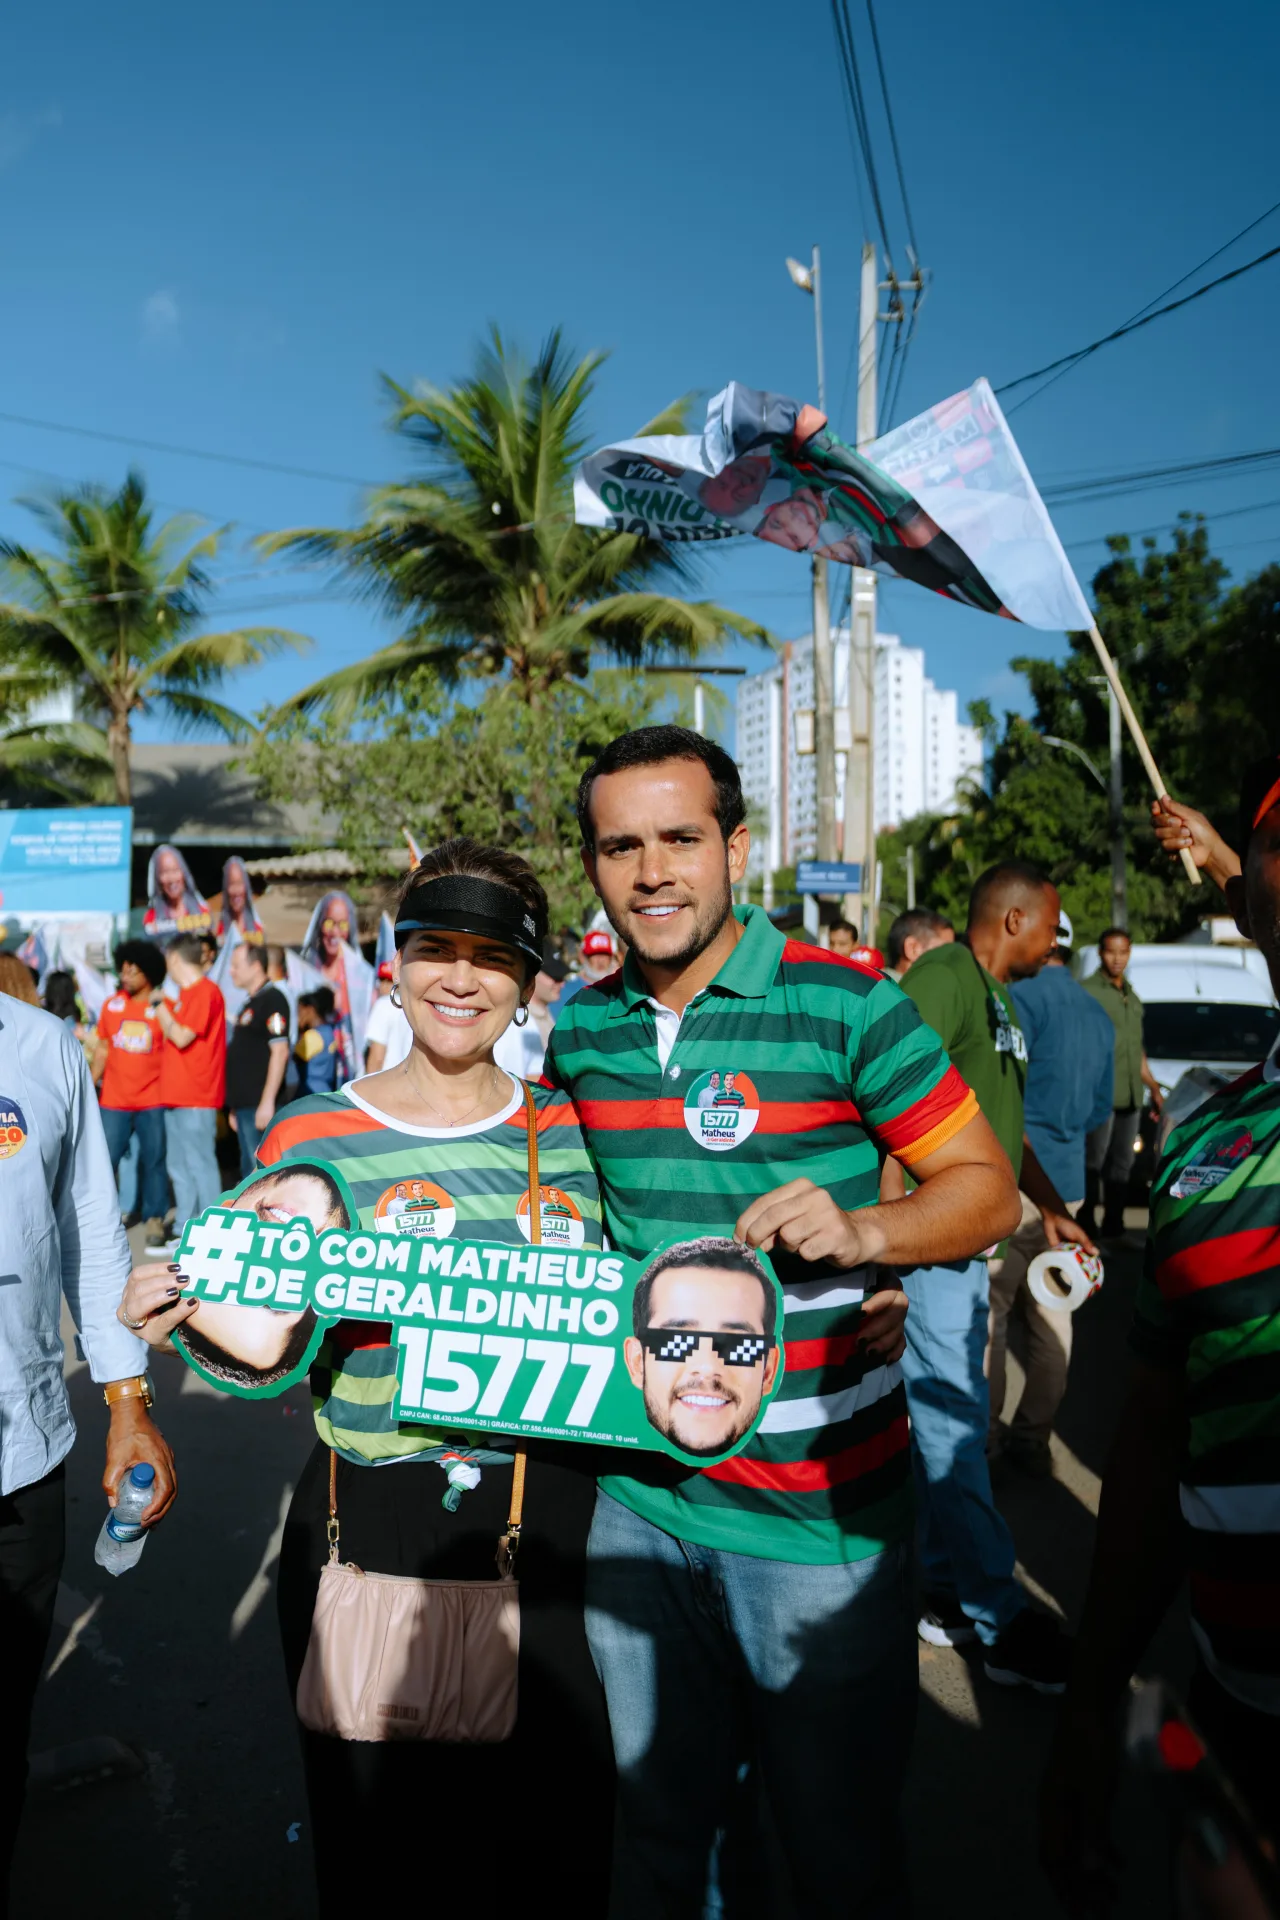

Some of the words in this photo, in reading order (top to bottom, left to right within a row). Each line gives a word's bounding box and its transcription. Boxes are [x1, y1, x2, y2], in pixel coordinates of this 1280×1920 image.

[0, 1112, 19, 1123] IA
[703, 1112, 737, 1127] 15777
[702, 1129, 736, 1138] Matheus
[397, 1213, 432, 1227] 15777
[319, 1234, 411, 1273] COM
[418, 1241, 625, 1292] MATHEUS
[243, 1265, 306, 1305] DE
[314, 1273, 619, 1337] GERALDINHO
[398, 1325, 616, 1428] 15777
[399, 1410, 415, 1418] CNPJ
[416, 1411, 432, 1420] CAN:
[491, 1420, 521, 1431] GRÁFICA:
[582, 1431, 614, 1441] TIRAGEM:
